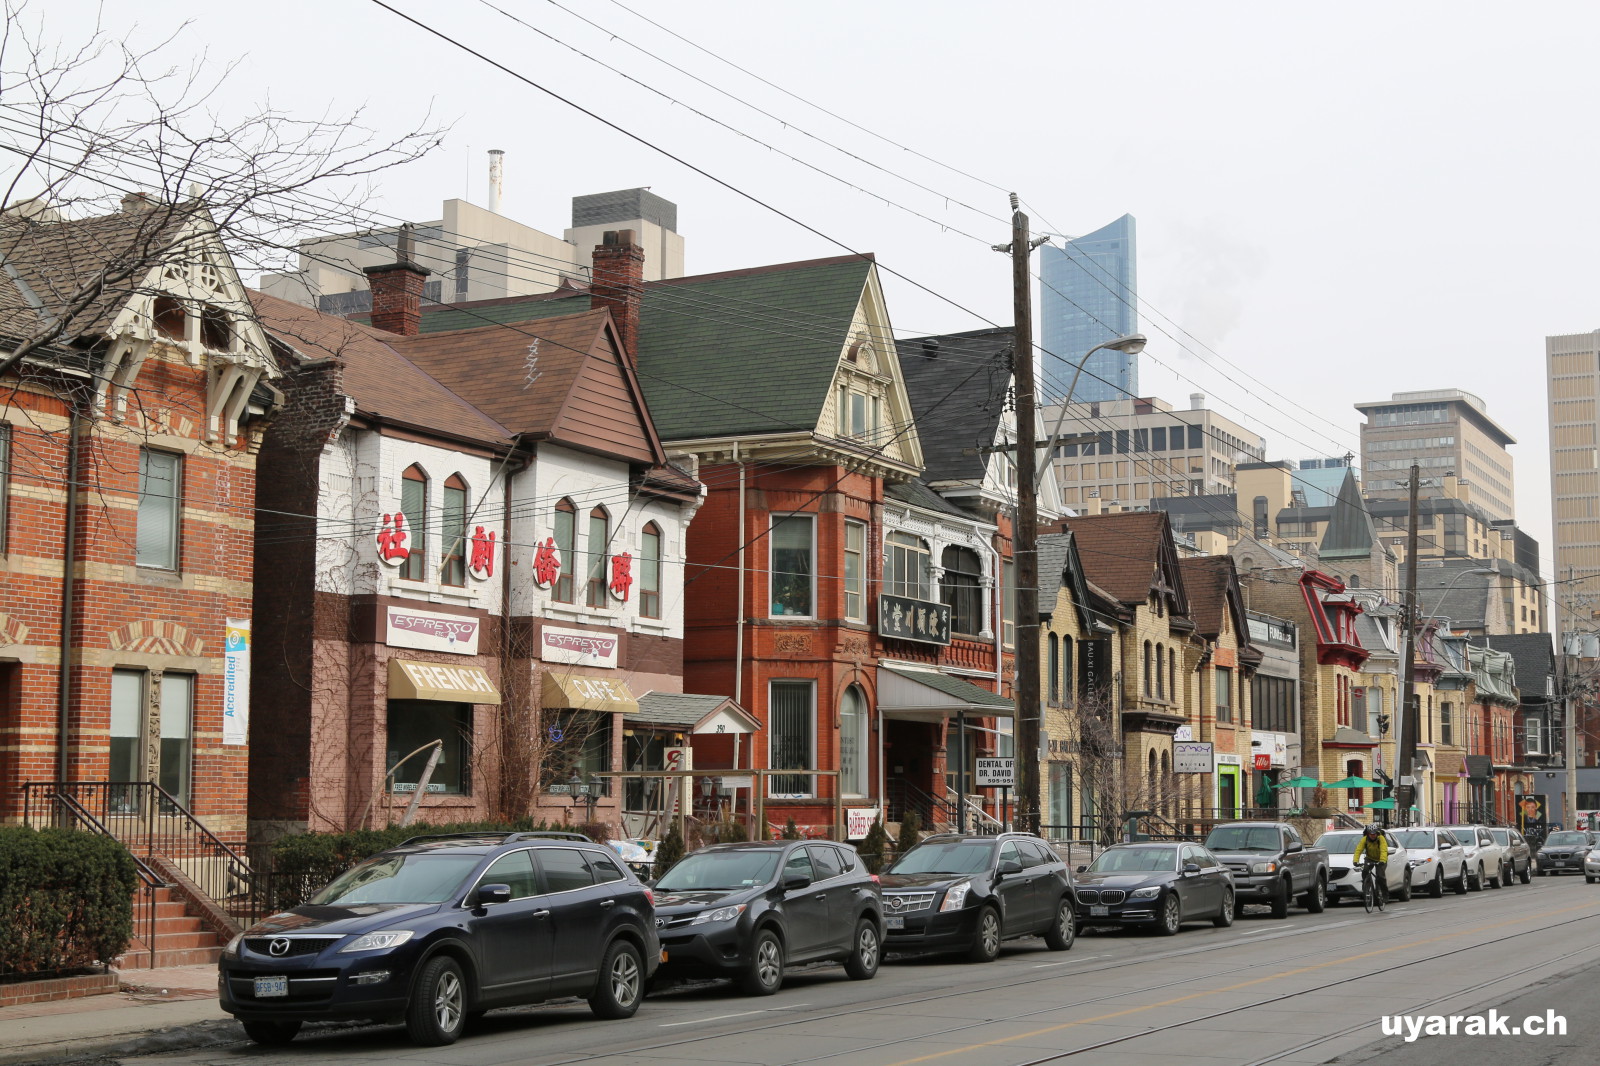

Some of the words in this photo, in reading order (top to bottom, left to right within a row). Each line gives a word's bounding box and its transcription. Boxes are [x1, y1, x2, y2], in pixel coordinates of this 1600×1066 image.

[394, 615, 473, 634] ESPRESSO
[547, 635, 613, 650] ESPRESSO
[225, 656, 236, 717] Accredited
[405, 664, 494, 693] FRENCH
[716, 724, 725, 733] 390
[1256, 757, 1269, 768] illy
[849, 817, 866, 836] BARBER
